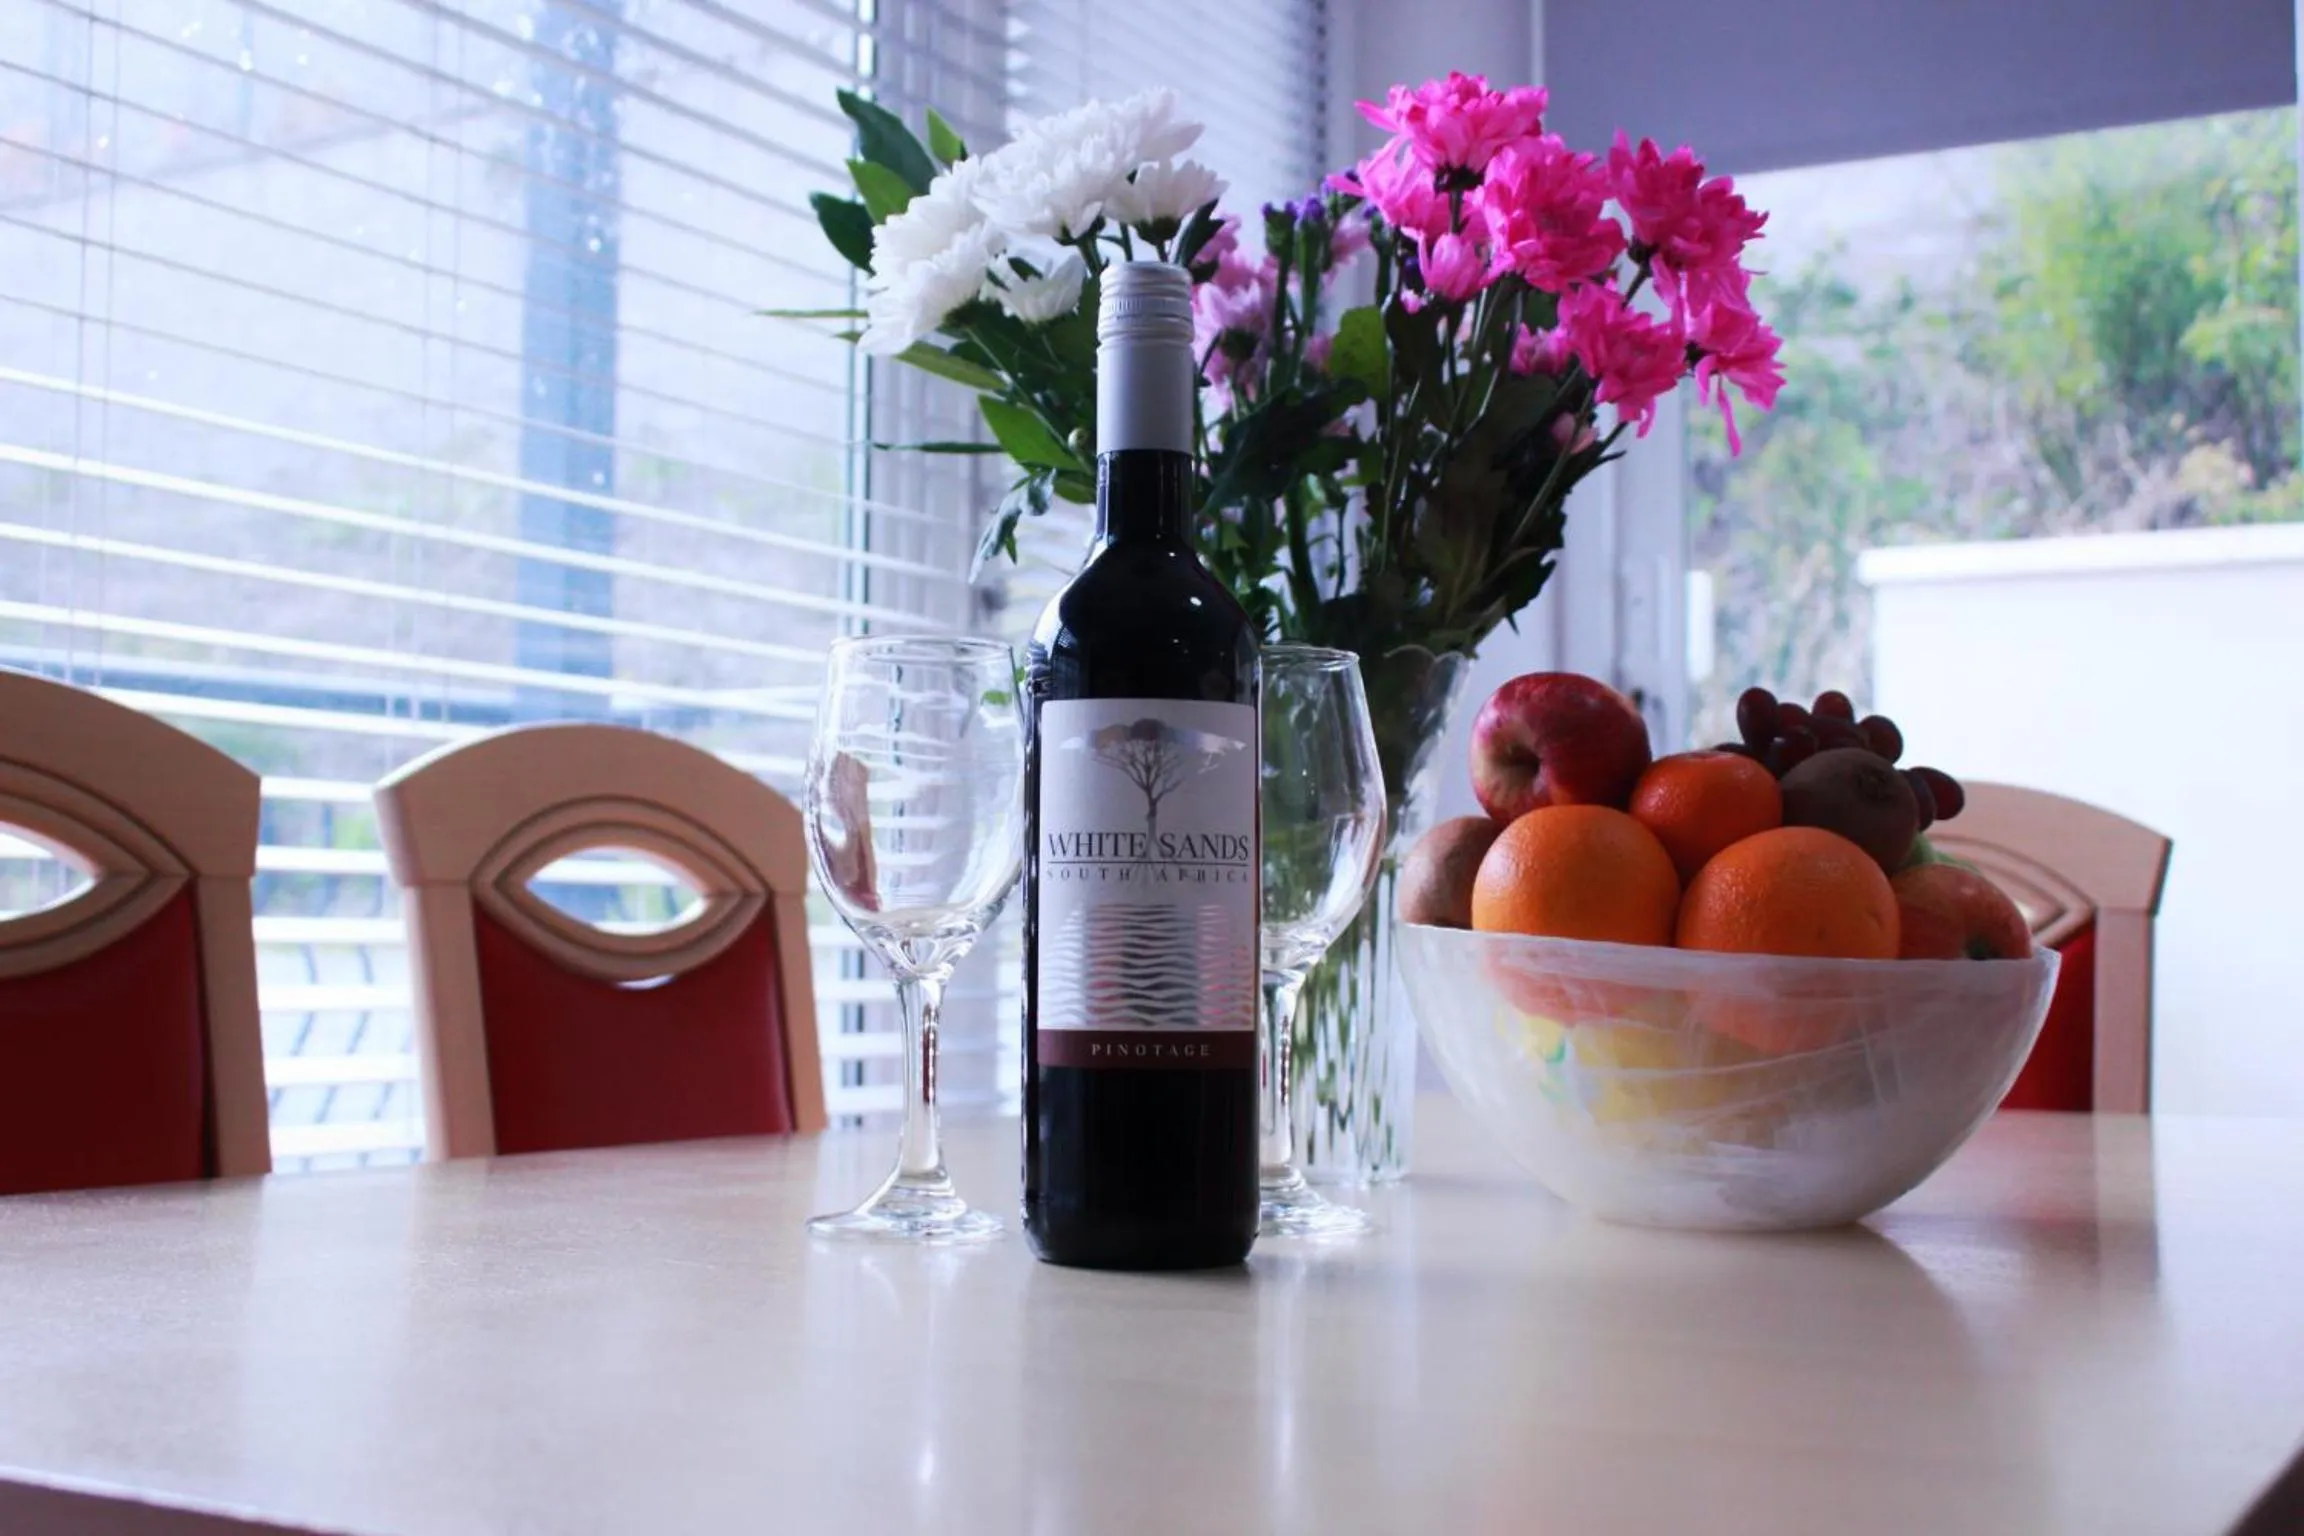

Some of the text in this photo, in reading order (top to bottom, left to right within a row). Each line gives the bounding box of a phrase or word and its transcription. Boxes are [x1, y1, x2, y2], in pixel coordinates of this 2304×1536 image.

[1048, 832, 1249, 862] WHITE SANDS
[1048, 866, 1131, 881] SOUTH
[1092, 1043, 1211, 1057] PINOTAGE
